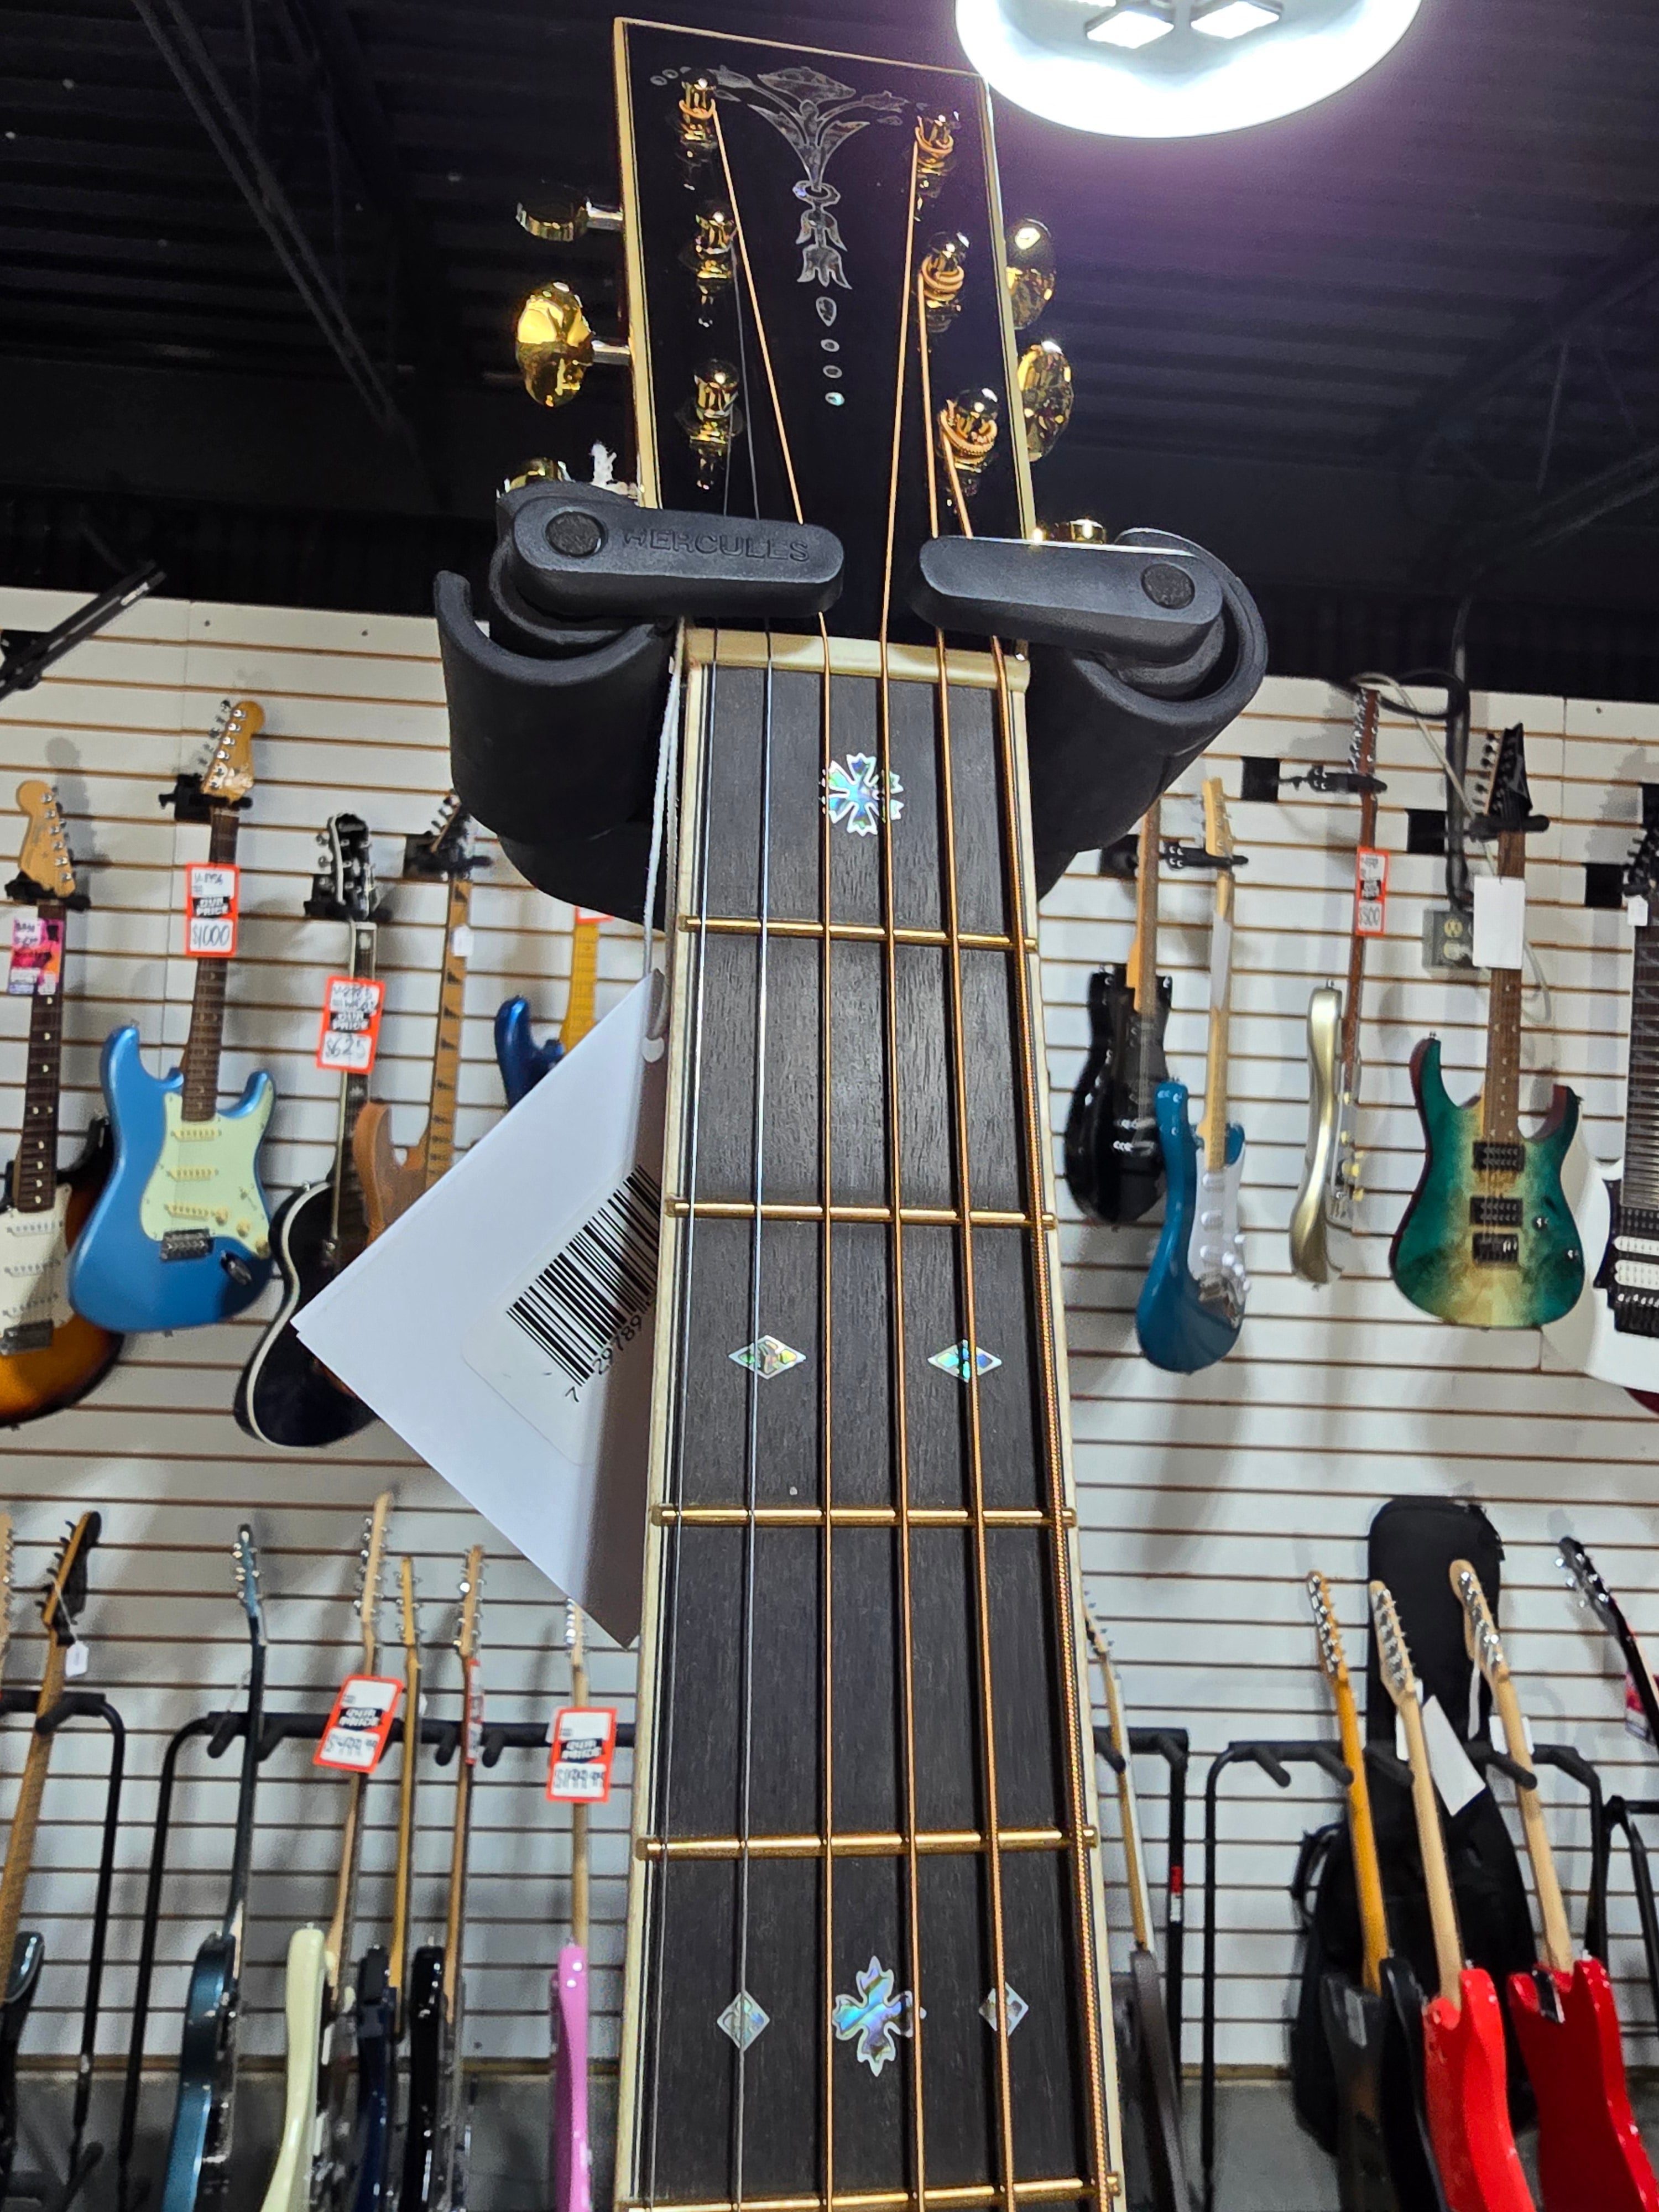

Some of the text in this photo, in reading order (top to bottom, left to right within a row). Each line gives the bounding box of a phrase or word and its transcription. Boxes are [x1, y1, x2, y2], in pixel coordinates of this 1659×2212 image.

[623, 528, 810, 562] HERCULES
[192, 925, 230, 948] $1000
[565, 1386, 580, 1404] 7
